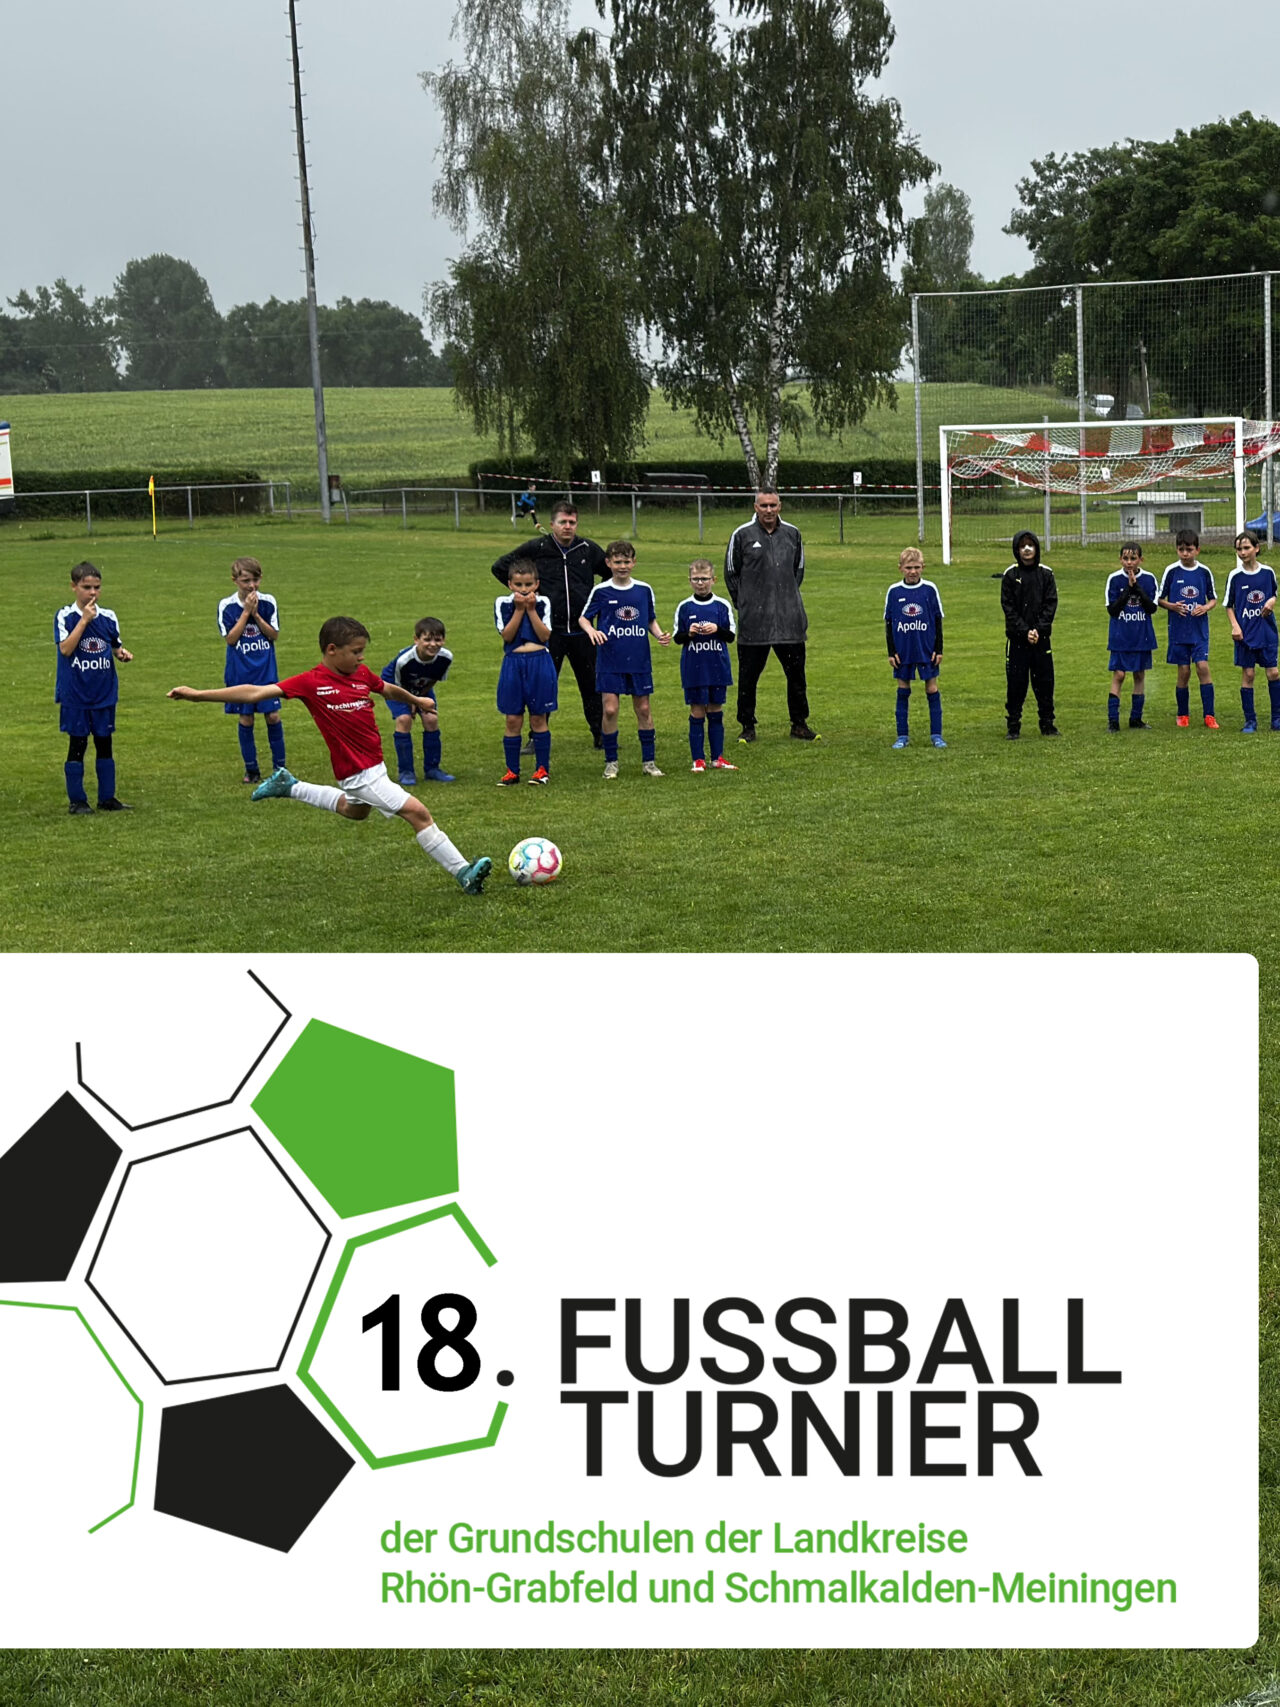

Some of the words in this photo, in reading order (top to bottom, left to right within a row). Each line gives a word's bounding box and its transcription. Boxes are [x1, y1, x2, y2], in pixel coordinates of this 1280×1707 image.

[607, 625, 646, 639] Apollo
[897, 620, 928, 634] Apollo
[235, 639, 271, 655] Apollo
[688, 640, 723, 654] Apollo
[71, 656, 111, 672] Apollo
